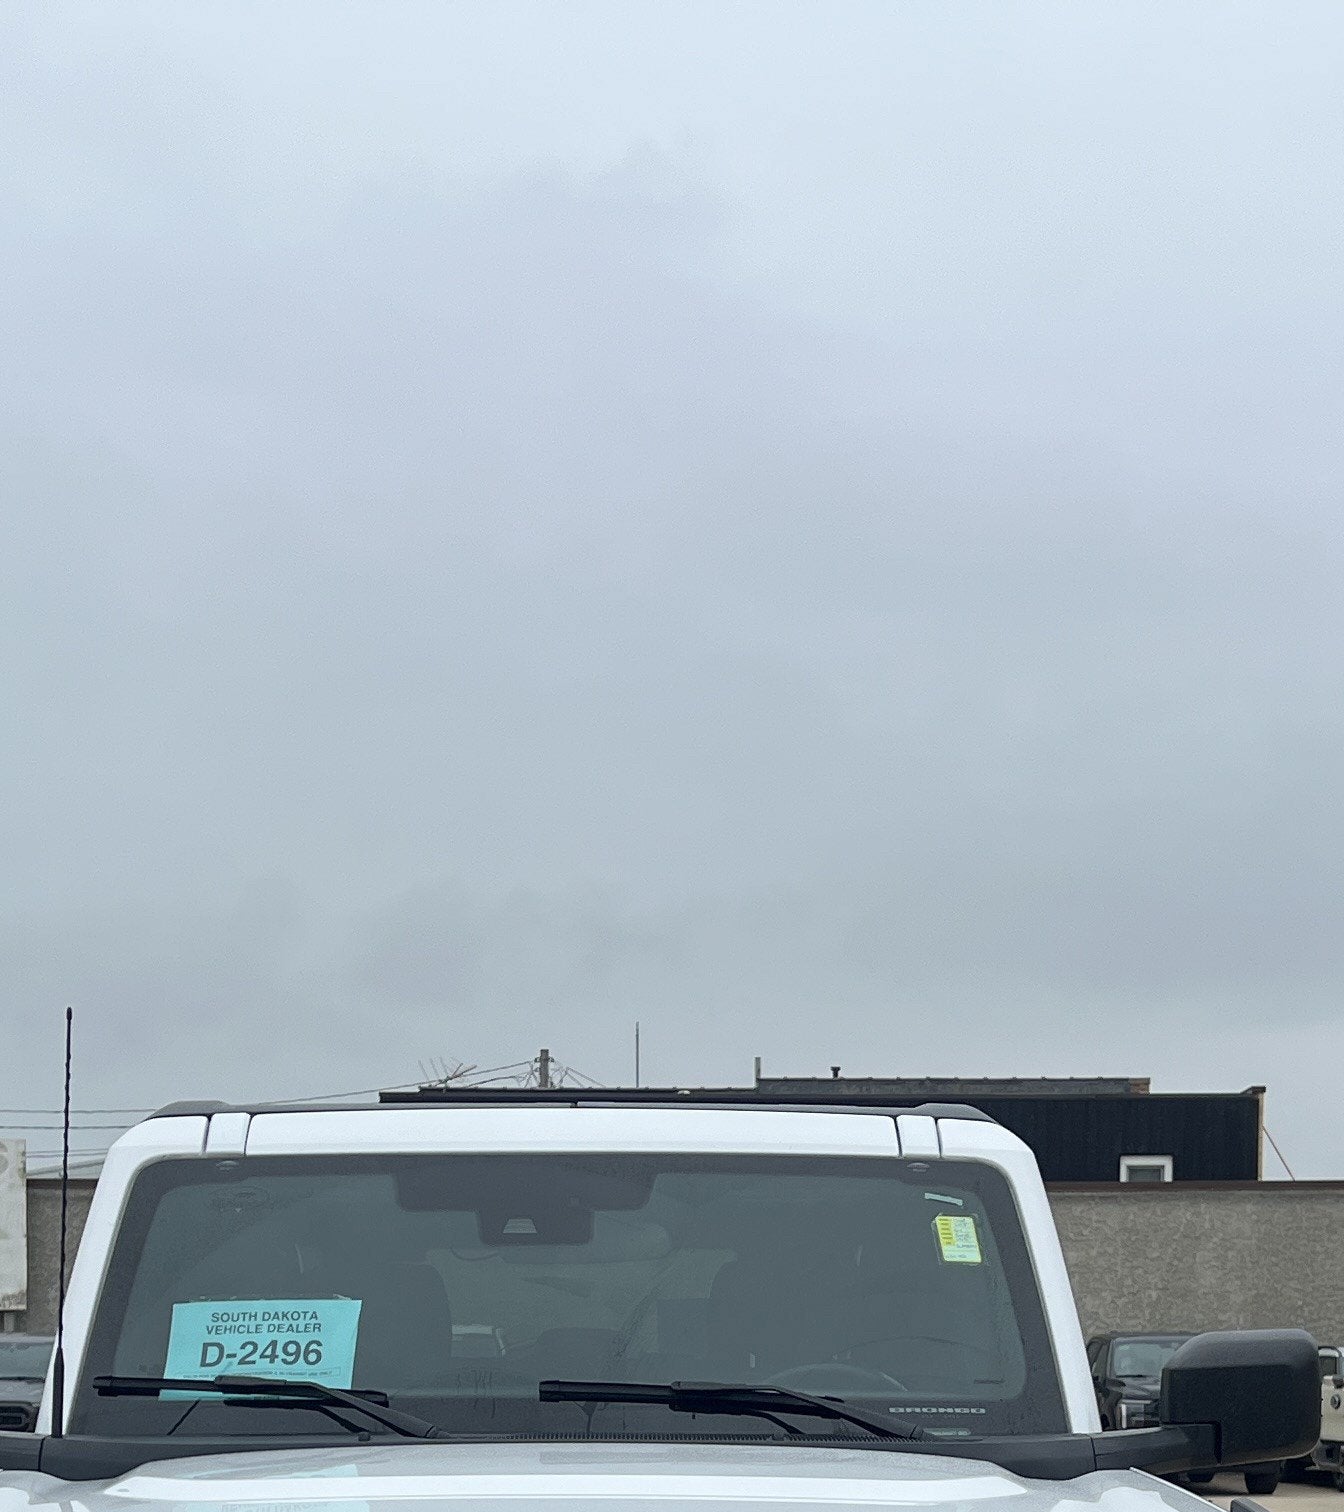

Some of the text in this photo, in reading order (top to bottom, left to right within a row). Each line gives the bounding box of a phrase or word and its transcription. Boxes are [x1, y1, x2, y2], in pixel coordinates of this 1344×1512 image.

[210, 1310, 319, 1323] SOUTH DAKOTA
[205, 1322, 323, 1336] VEHICLE DEALER
[199, 1339, 324, 1369] D-2496
